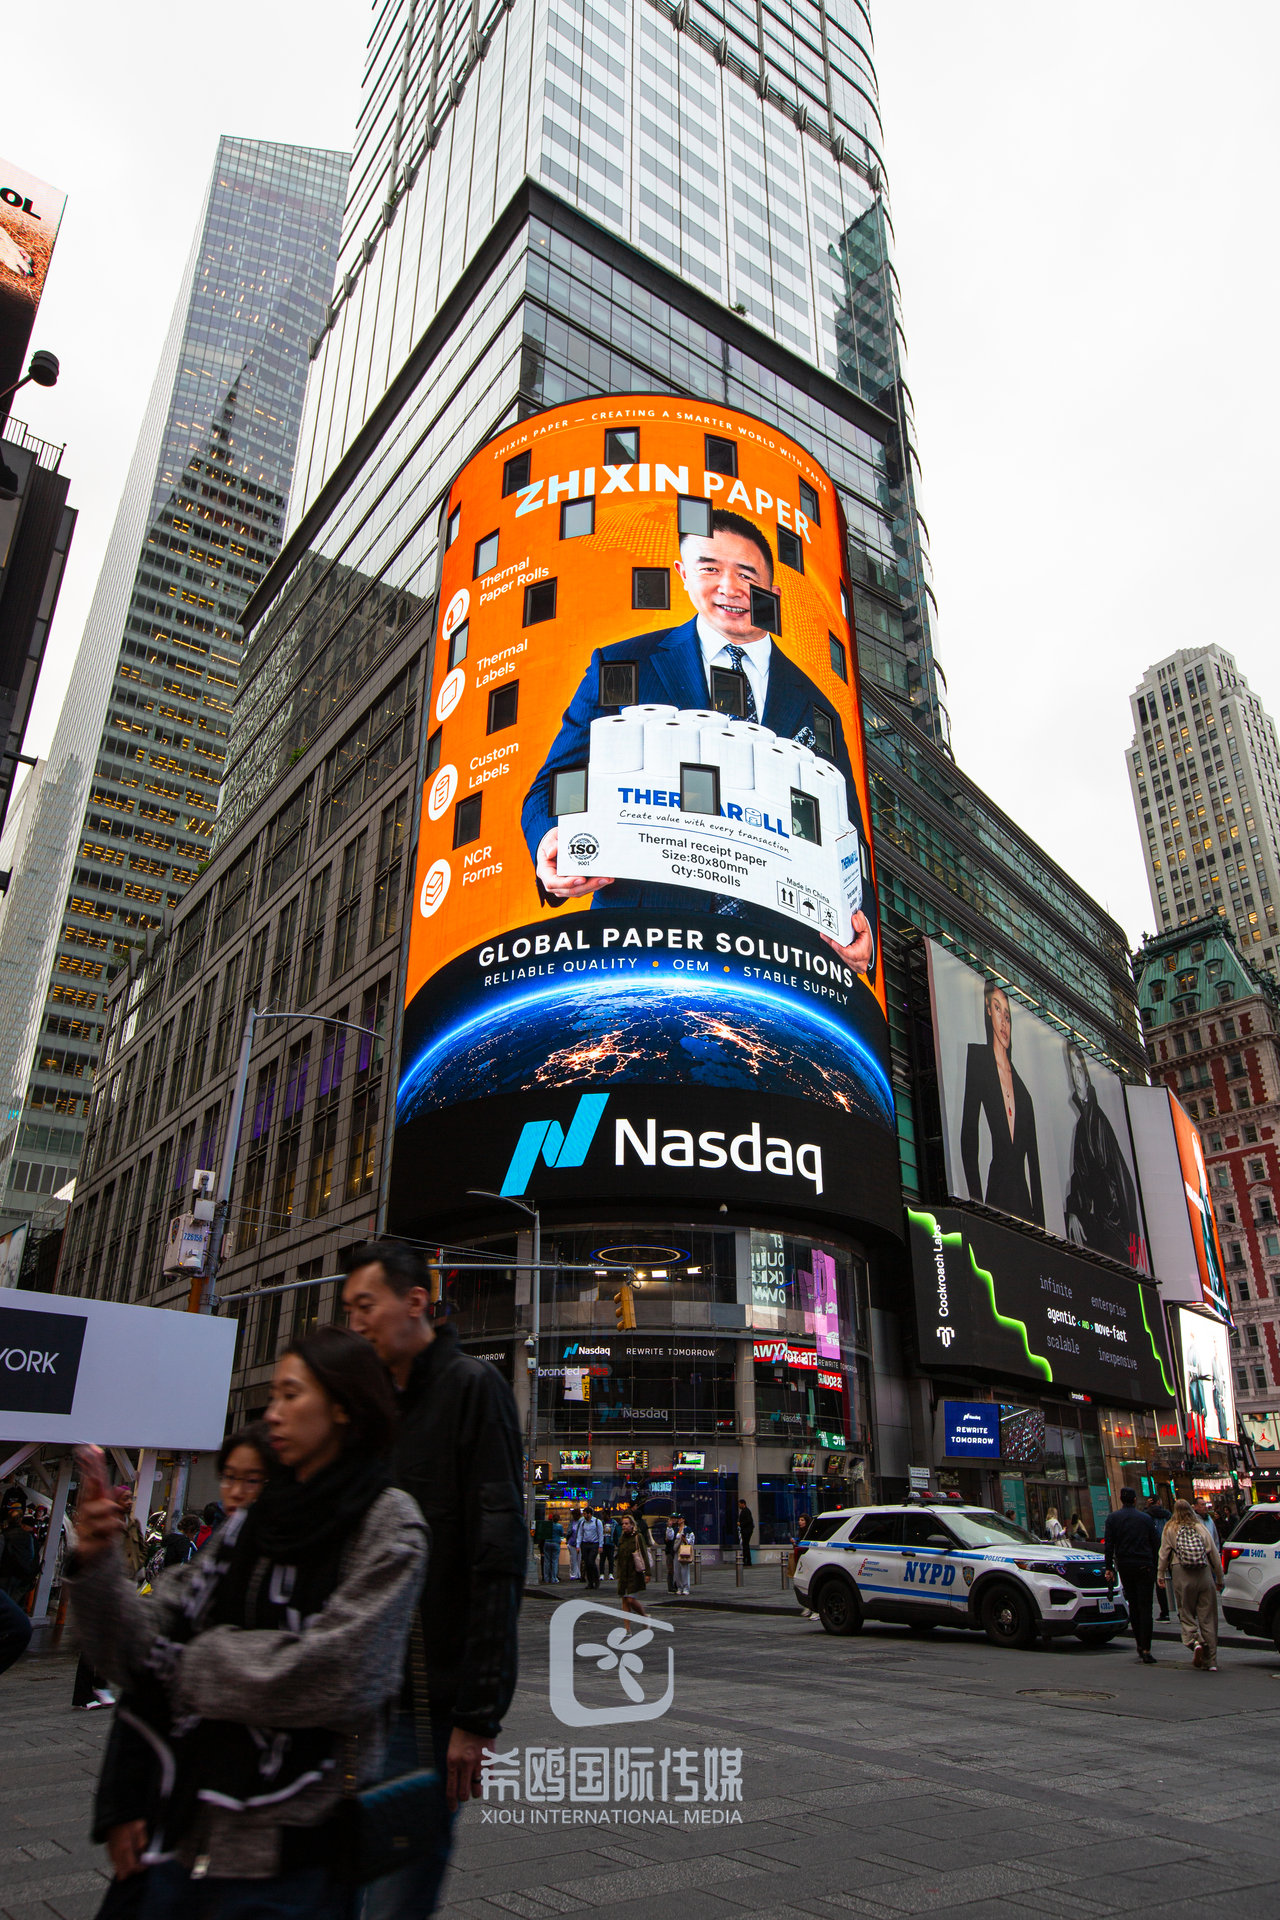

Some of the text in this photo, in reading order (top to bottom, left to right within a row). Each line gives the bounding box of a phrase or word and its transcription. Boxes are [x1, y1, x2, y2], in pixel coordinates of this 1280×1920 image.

[494, 409, 828, 493] ZHIXIN PAPER CREATING A SMARTER WORLD WITH PAPER
[515, 463, 812, 544] ZHIXIN PAPER
[480, 556, 530, 590] Thermal
[479, 567, 550, 606] Paper Rolls
[476, 638, 528, 671] Thermal
[475, 662, 516, 688] Labels
[469, 742, 520, 770] Custom
[468, 762, 510, 788] Labels
[619, 810, 790, 854] Create value with every transaction
[463, 846, 492, 868] NCR
[569, 844, 597, 855] ISO
[638, 832, 768, 868] Thermal receipt paper
[661, 849, 749, 876] Size:80x80mm
[462, 862, 503, 886] Forms
[671, 864, 741, 888] Qty:50Rolls
[786, 877, 804, 891] Made
[805, 885, 812, 893] in
[812, 888, 830, 904] China
[478, 928, 854, 989] GLOBAL PAPER SOLUTIONS
[484, 957, 849, 1006] RELIABLE QUALITY OEM STABLE SUPPLY
[615, 1118, 824, 1195] Nasdaq
[932, 1224, 949, 1317] Cockroach Labs
[1040, 1275, 1073, 1299] infinite
[1090, 1296, 1127, 1318] enterprise
[1047, 1307, 1077, 1327] agentic
[1094, 1322, 1128, 1342] move-fast
[578, 1345, 716, 1357] Nasdaq REWRITE TOMORROW
[1046, 1335, 1080, 1355] scalable
[1098, 1347, 1138, 1370] inexpensive
[623, 1407, 669, 1421] Nasdaq
[951, 1436, 994, 1445] TOMORROW
[956, 1426, 988, 1434] REWRITE
[984, 1554, 1006, 1563] POLICE
[904, 1561, 956, 1587] NYPD
